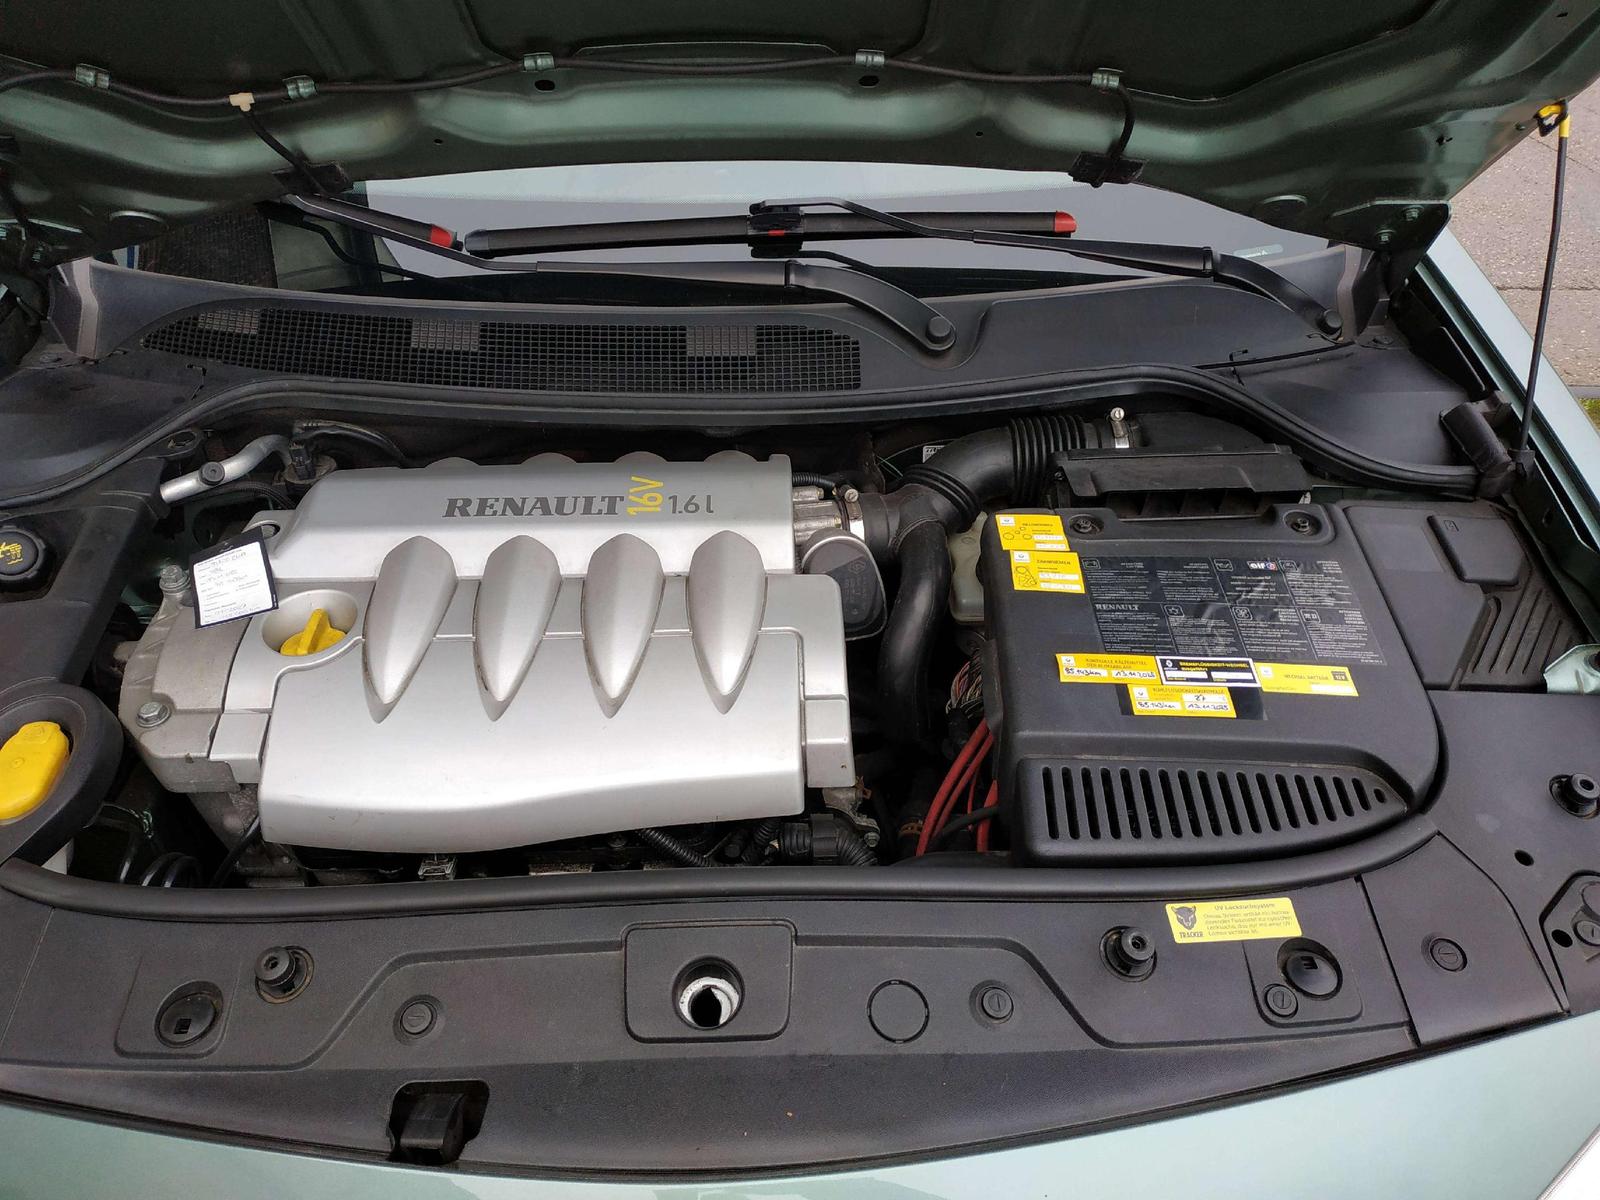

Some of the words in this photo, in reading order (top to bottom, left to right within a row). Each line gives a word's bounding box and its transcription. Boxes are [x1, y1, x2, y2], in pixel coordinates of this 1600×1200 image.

[626, 475, 664, 517] 16V
[442, 495, 625, 518] RENAULT
[1250, 562, 1265, 570] elf
[1094, 603, 1140, 611] RENAULT
[1179, 931, 1204, 939] TRACKER
